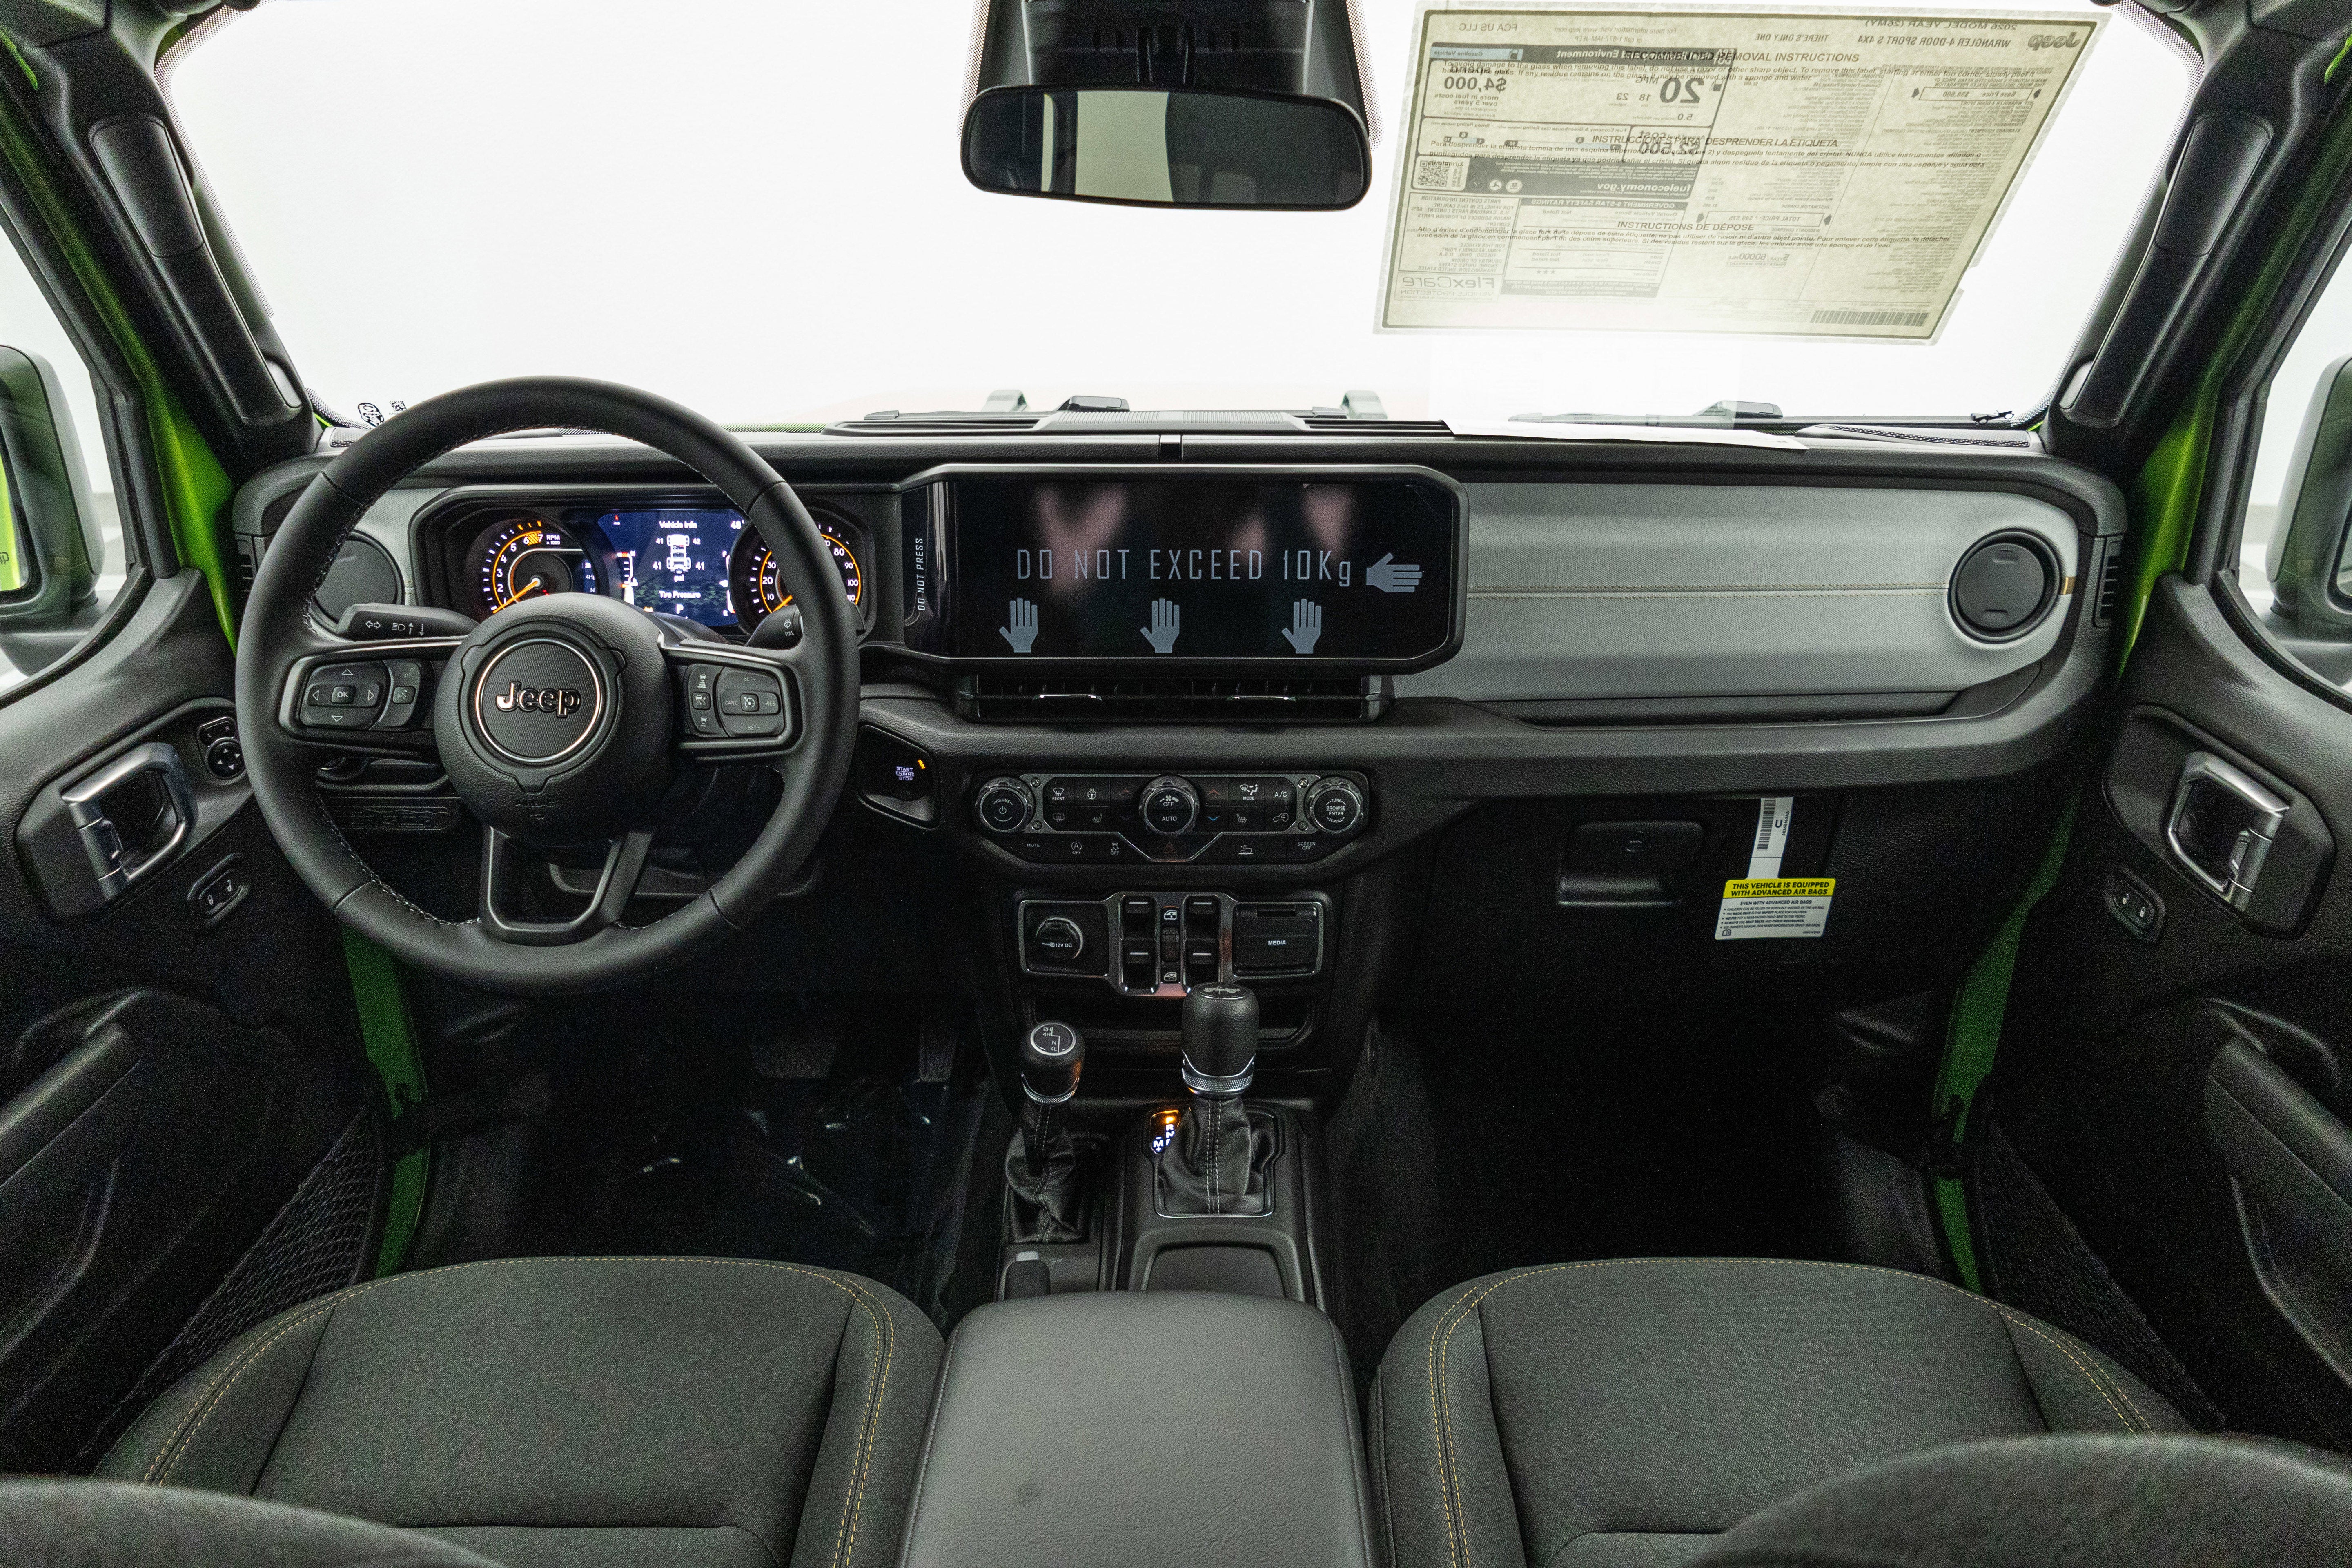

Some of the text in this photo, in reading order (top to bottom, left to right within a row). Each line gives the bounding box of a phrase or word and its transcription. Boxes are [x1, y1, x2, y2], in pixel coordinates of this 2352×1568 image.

[1717, 53, 1771, 61] REMOVAL
[1775, 53, 1860, 62] INSTRUCTIONS
[1592, 136, 1672, 144] INSTRUCCIONES
[1706, 137, 1773, 146] DESPRENDER
[1617, 221, 1693, 231] INSTRUCTIONS
[1713, 223, 1756, 231] DÉPOSE
[537, 534, 543, 542] 7
[510, 543, 517, 552] 5
[501, 555, 507, 563] 4
[653, 561, 662, 570] 41
[695, 561, 705, 570] 41
[1017, 550, 1351, 587] DO NOT EXCEED 10Kg
[497, 568, 503, 577] 3
[915, 538, 925, 611] DO NOT PRESS
[497, 584, 503, 592] 2
[676, 604, 684, 614] P
[496, 681, 581, 718] Jeep
